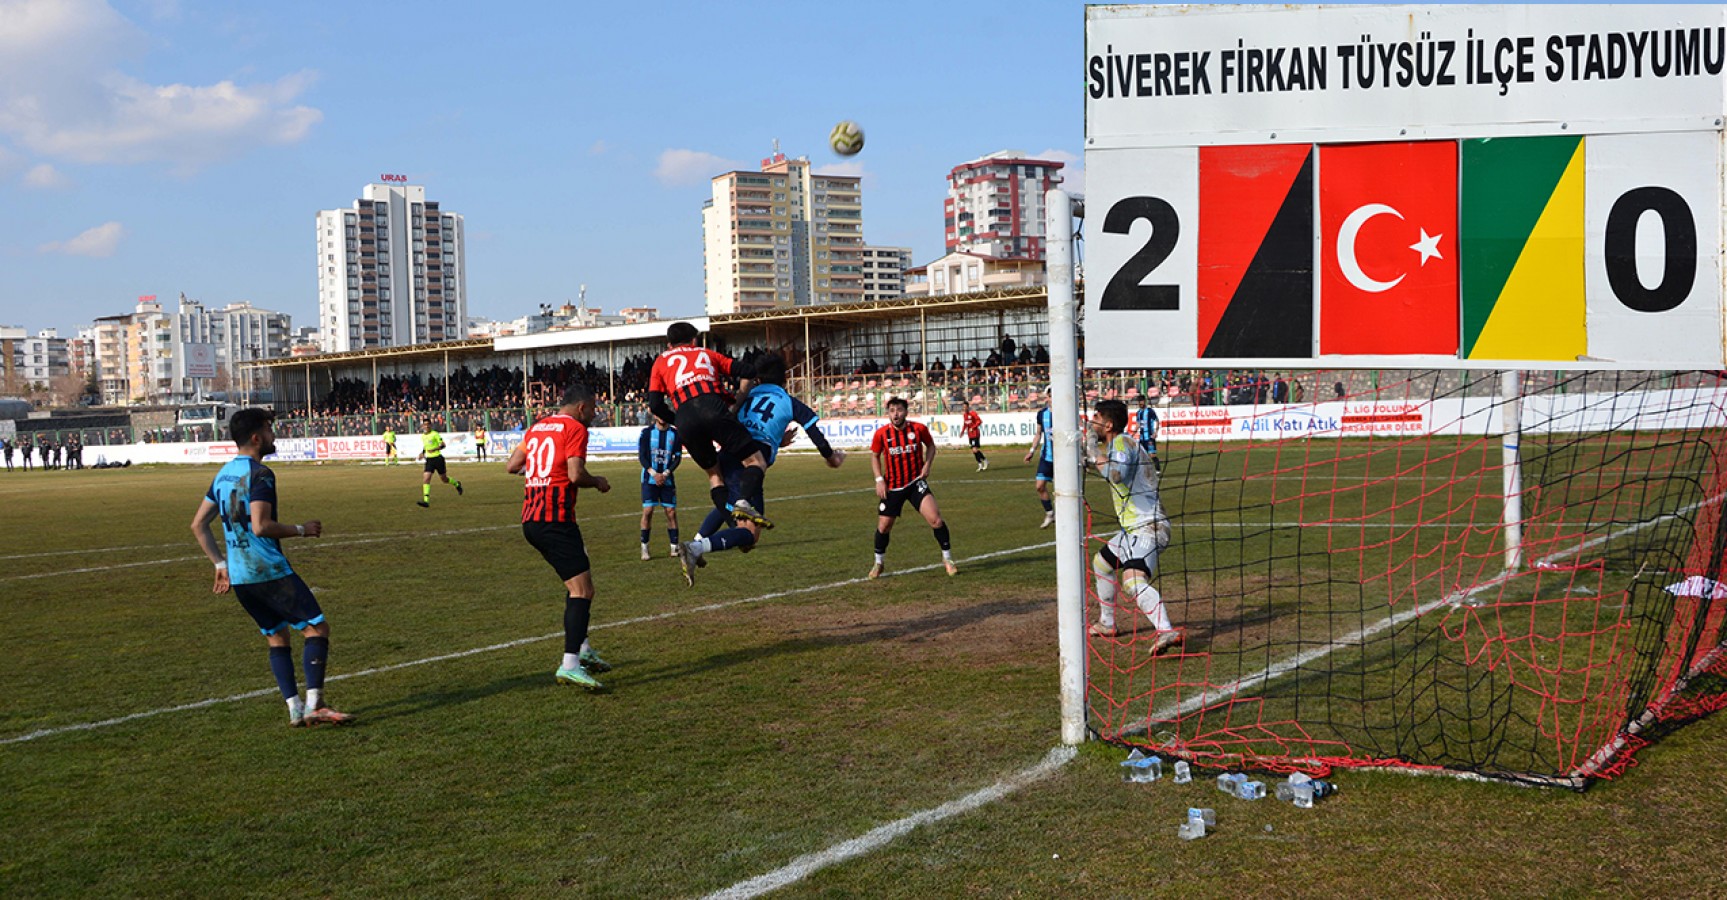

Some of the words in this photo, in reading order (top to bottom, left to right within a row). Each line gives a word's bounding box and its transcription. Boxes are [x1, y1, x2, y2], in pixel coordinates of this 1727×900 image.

[1089, 44, 1212, 99] SİVEREK
[1221, 38, 1327, 93] FİRKAN
[1337, 32, 1456, 89] TÜYSÜZ
[1466, 28, 1535, 96] İLÇE
[1545, 27, 1726, 82] STADYUMU
[1100, 196, 1180, 311] 2
[1604, 186, 1697, 312] 0
[667, 351, 715, 389] 24
[743, 396, 775, 423] 14
[1189, 409, 1229, 417] YOLUNDA
[1241, 419, 1269, 431] Adil
[1273, 418, 1302, 431] Katı
[1307, 417, 1337, 431] Atık
[526, 436, 555, 478] 30
